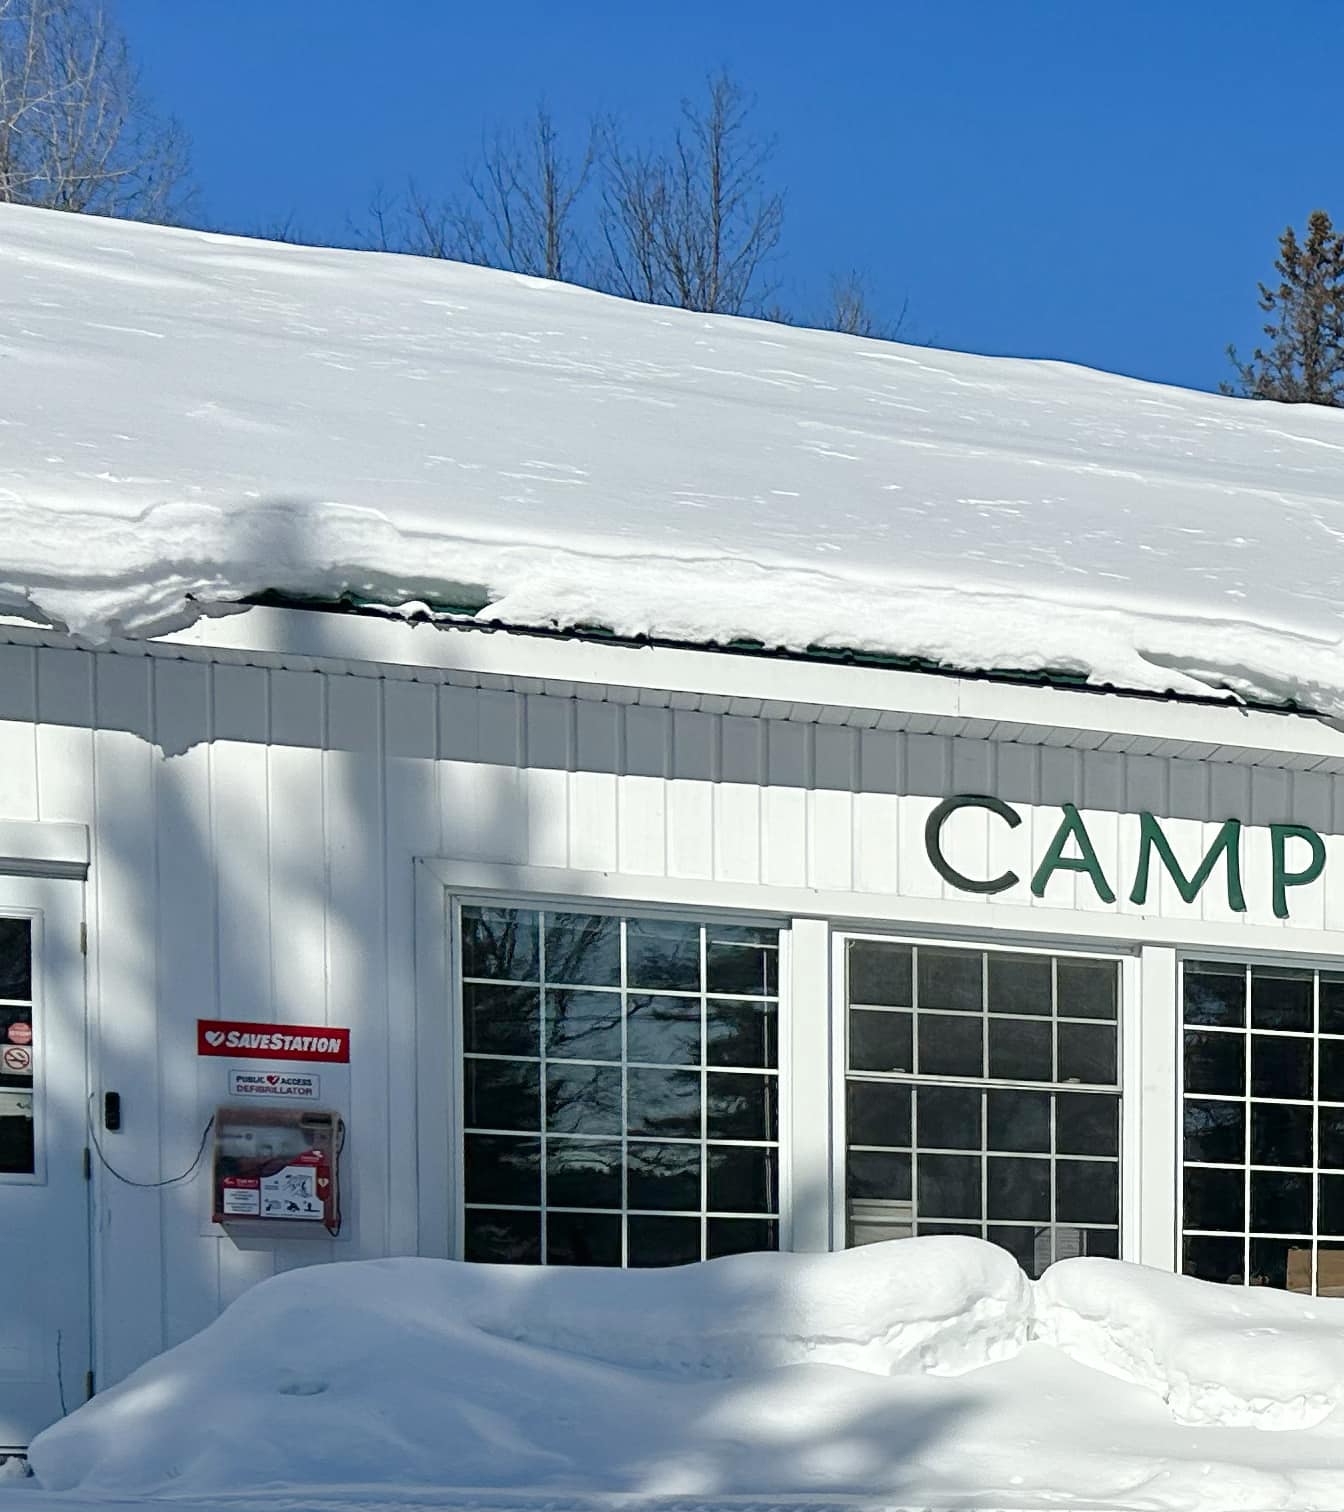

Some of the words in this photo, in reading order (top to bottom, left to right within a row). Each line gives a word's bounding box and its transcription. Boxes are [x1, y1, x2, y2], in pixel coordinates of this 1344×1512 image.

[925, 793, 1327, 919] CAMP
[236, 1075, 264, 1084] PUBLIC
[236, 1085, 313, 1096] DEFIBRILLATOR
